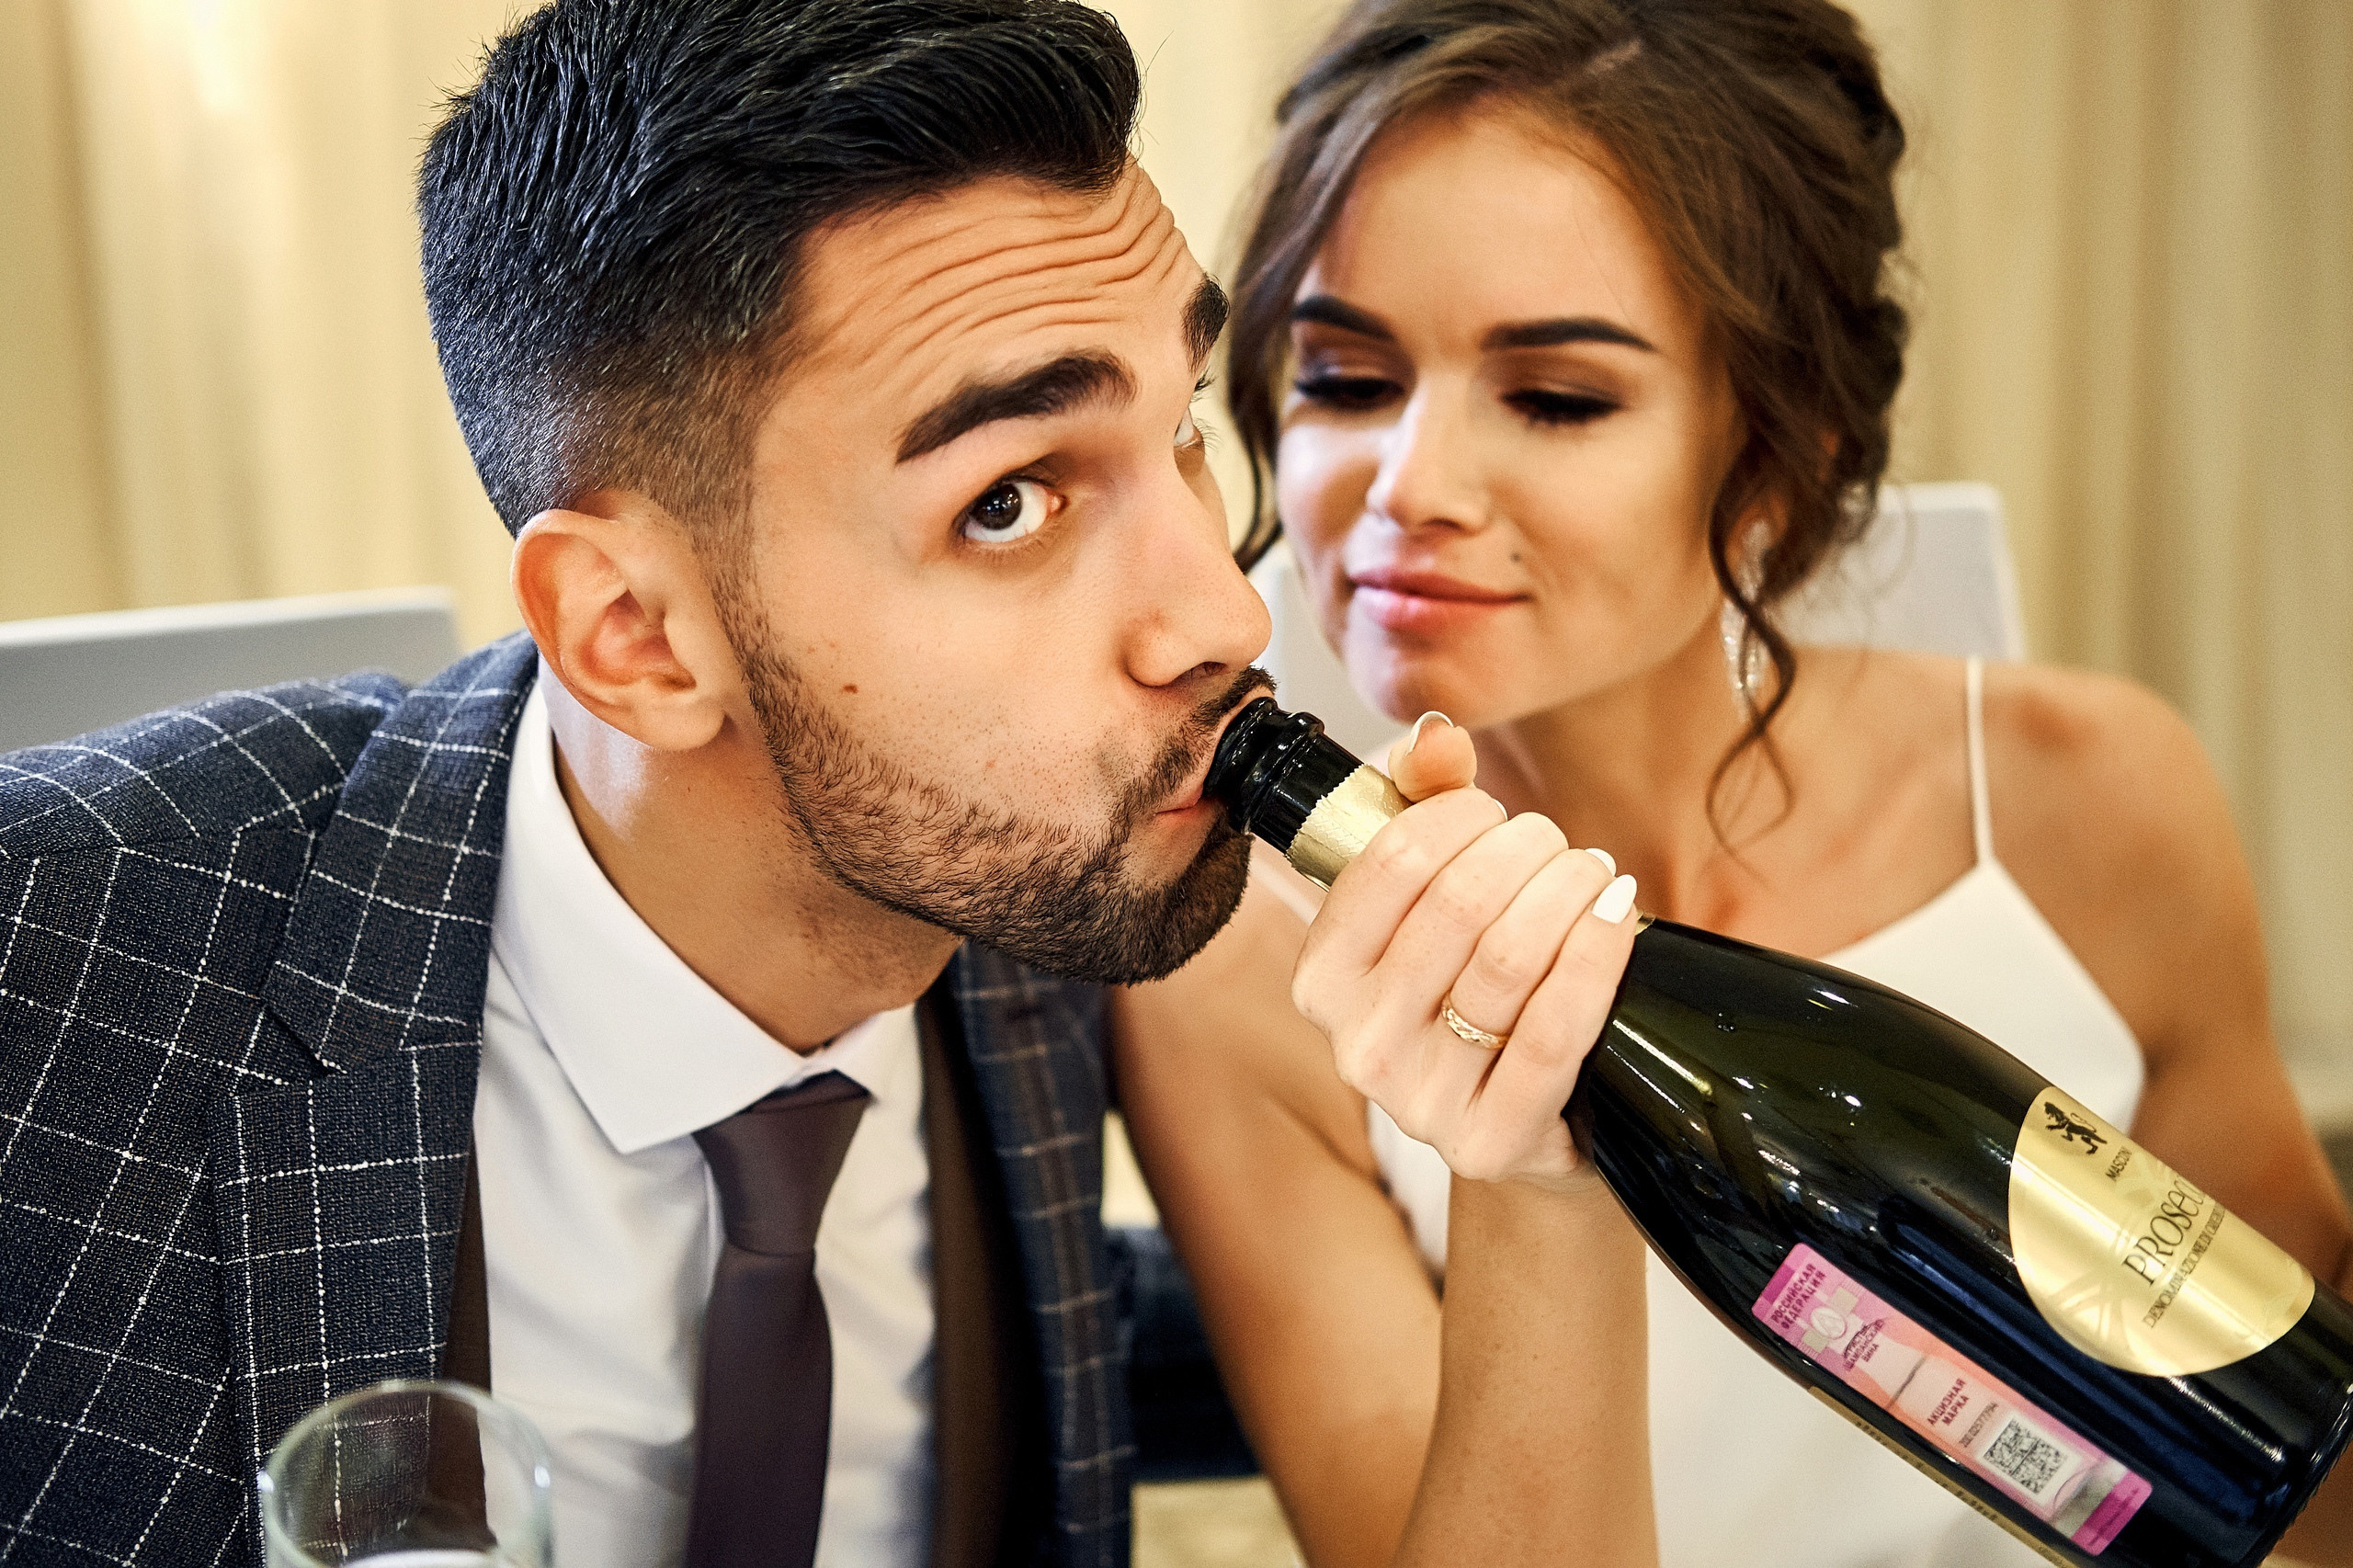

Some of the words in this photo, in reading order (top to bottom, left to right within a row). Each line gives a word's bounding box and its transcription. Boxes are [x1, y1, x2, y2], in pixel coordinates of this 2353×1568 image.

[1770, 1263, 1816, 1324] РОССИЙСКАЯ
[1780, 1270, 1826, 1330] ФЕДЕРАЦИЯ
[1860, 1343, 1880, 1362] ВИНА
[1927, 1378, 1966, 1426] АКЦИЗНАЯ
[1941, 1394, 1969, 1426] МАРКА
